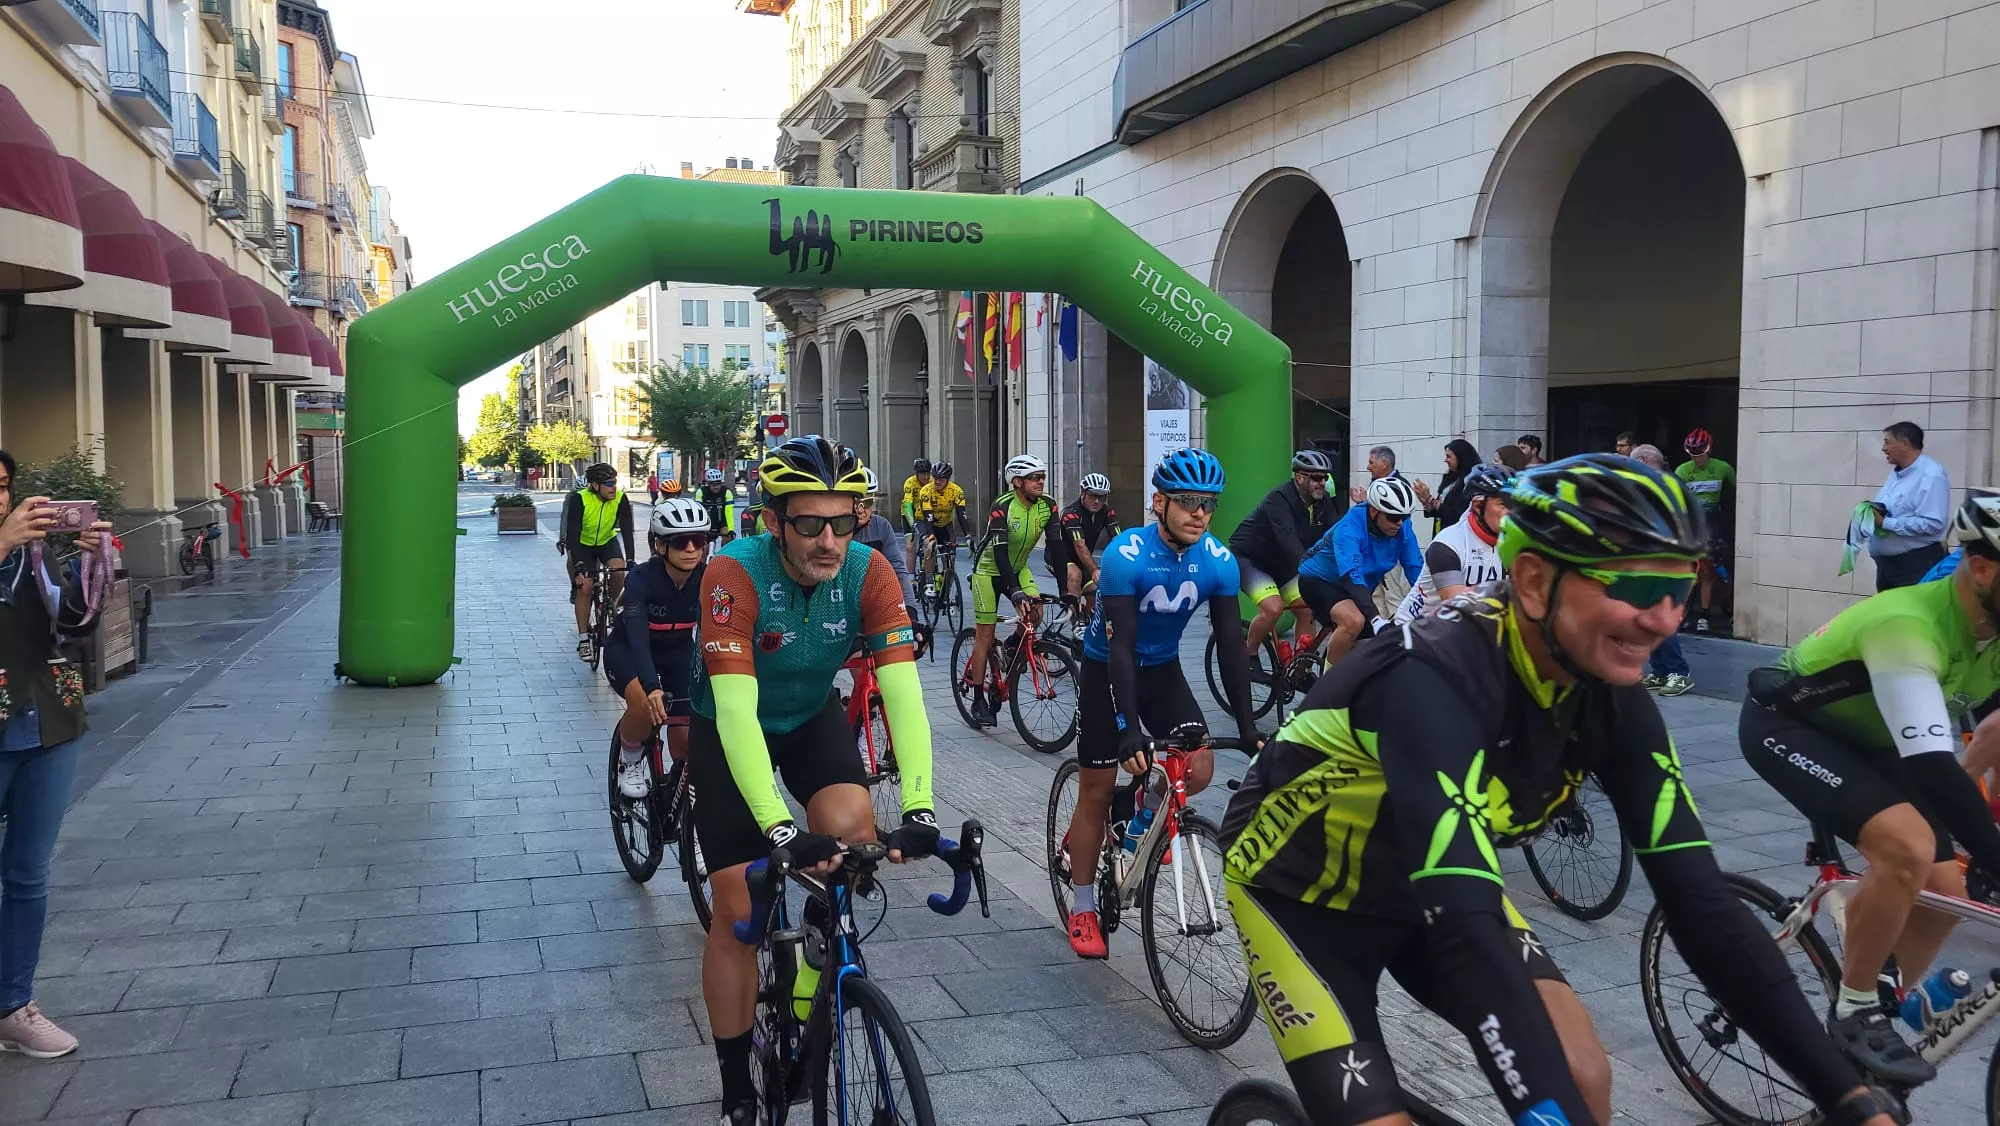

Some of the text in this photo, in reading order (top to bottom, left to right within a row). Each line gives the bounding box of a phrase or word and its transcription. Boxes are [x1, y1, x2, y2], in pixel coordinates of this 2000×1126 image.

[849, 219, 984, 244] PIRINEOS
[1160, 419, 1178, 429] VIAJES
[1465, 565, 1499, 587] UA
[1479, 1012, 1530, 1101] Tarbes
